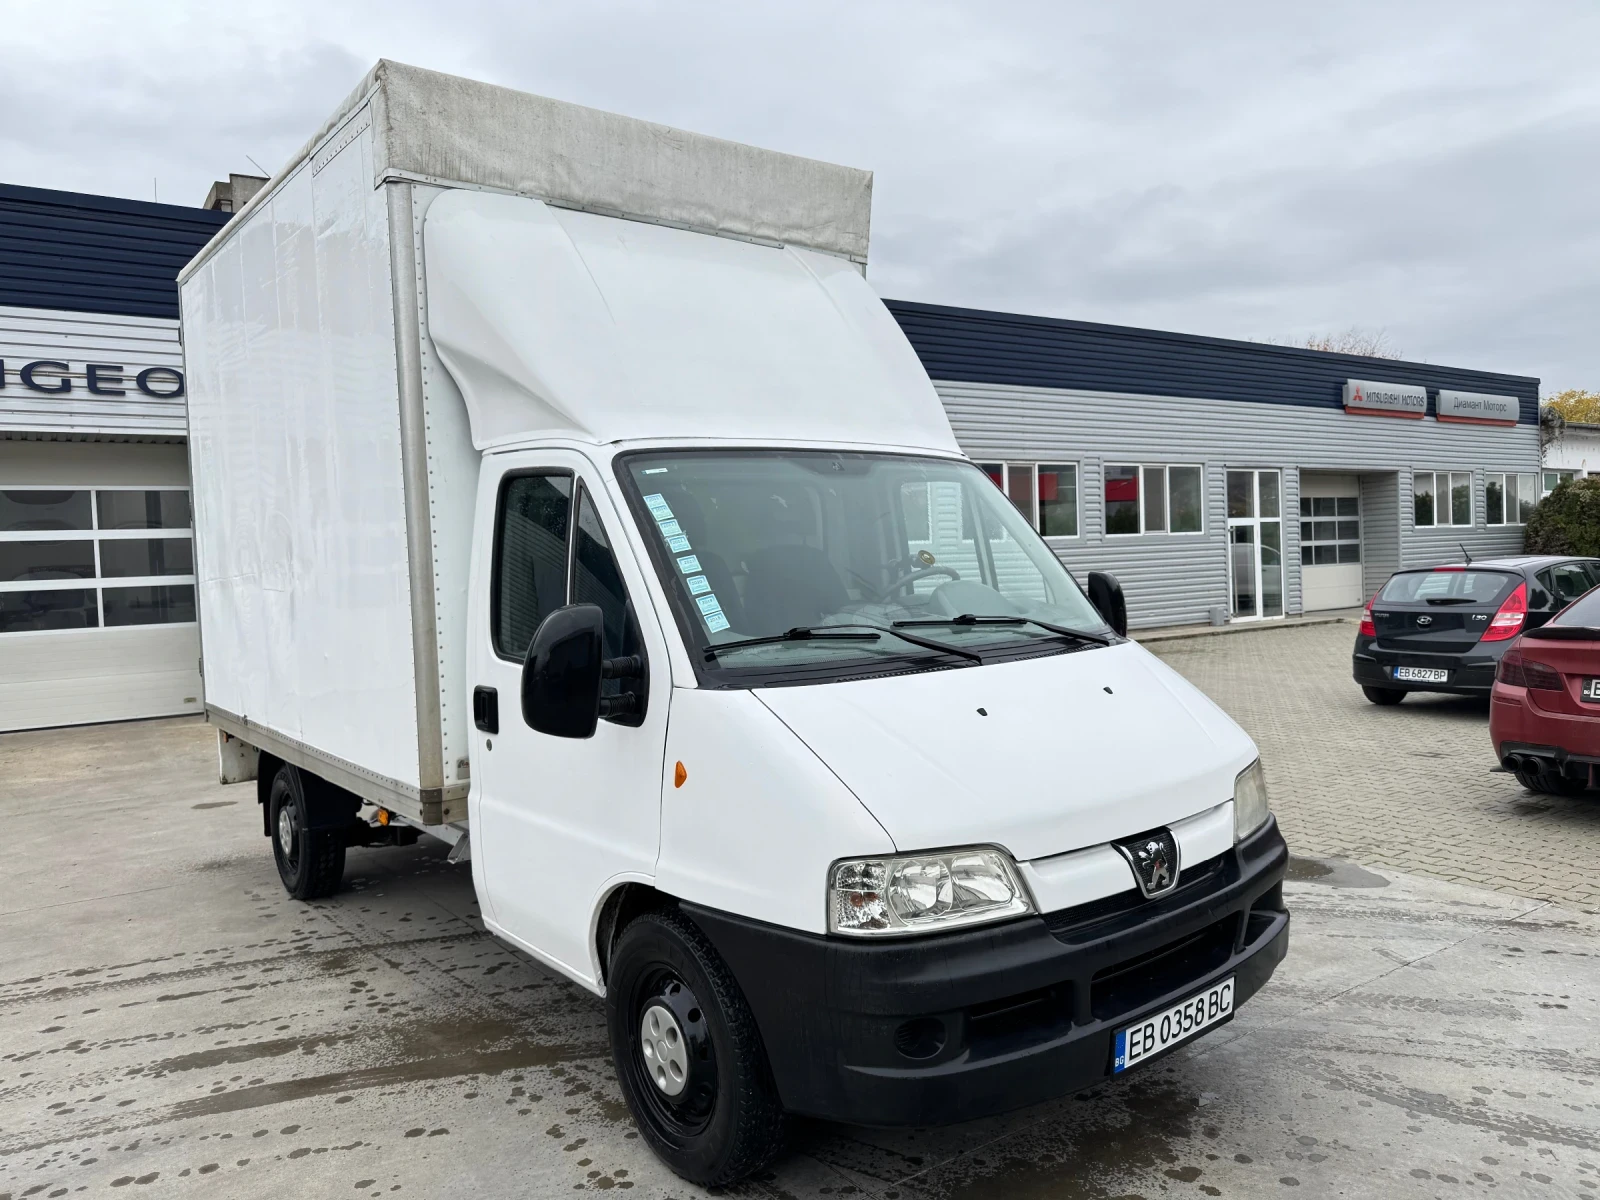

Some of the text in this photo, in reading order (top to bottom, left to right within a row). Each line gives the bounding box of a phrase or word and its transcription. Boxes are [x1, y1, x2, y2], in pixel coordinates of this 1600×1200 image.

[0, 358, 184, 398] GEO
[1366, 391, 1424, 407] MITSUBISHI MOTORS
[1453, 397, 1507, 413] Диамант Моторс
[1399, 668, 1410, 677] EB
[1412, 669, 1433, 678] 6827
[1434, 670, 1446, 680] BP
[1129, 984, 1231, 1061] EB 0358 BC
[1115, 1055, 1124, 1068] BG
